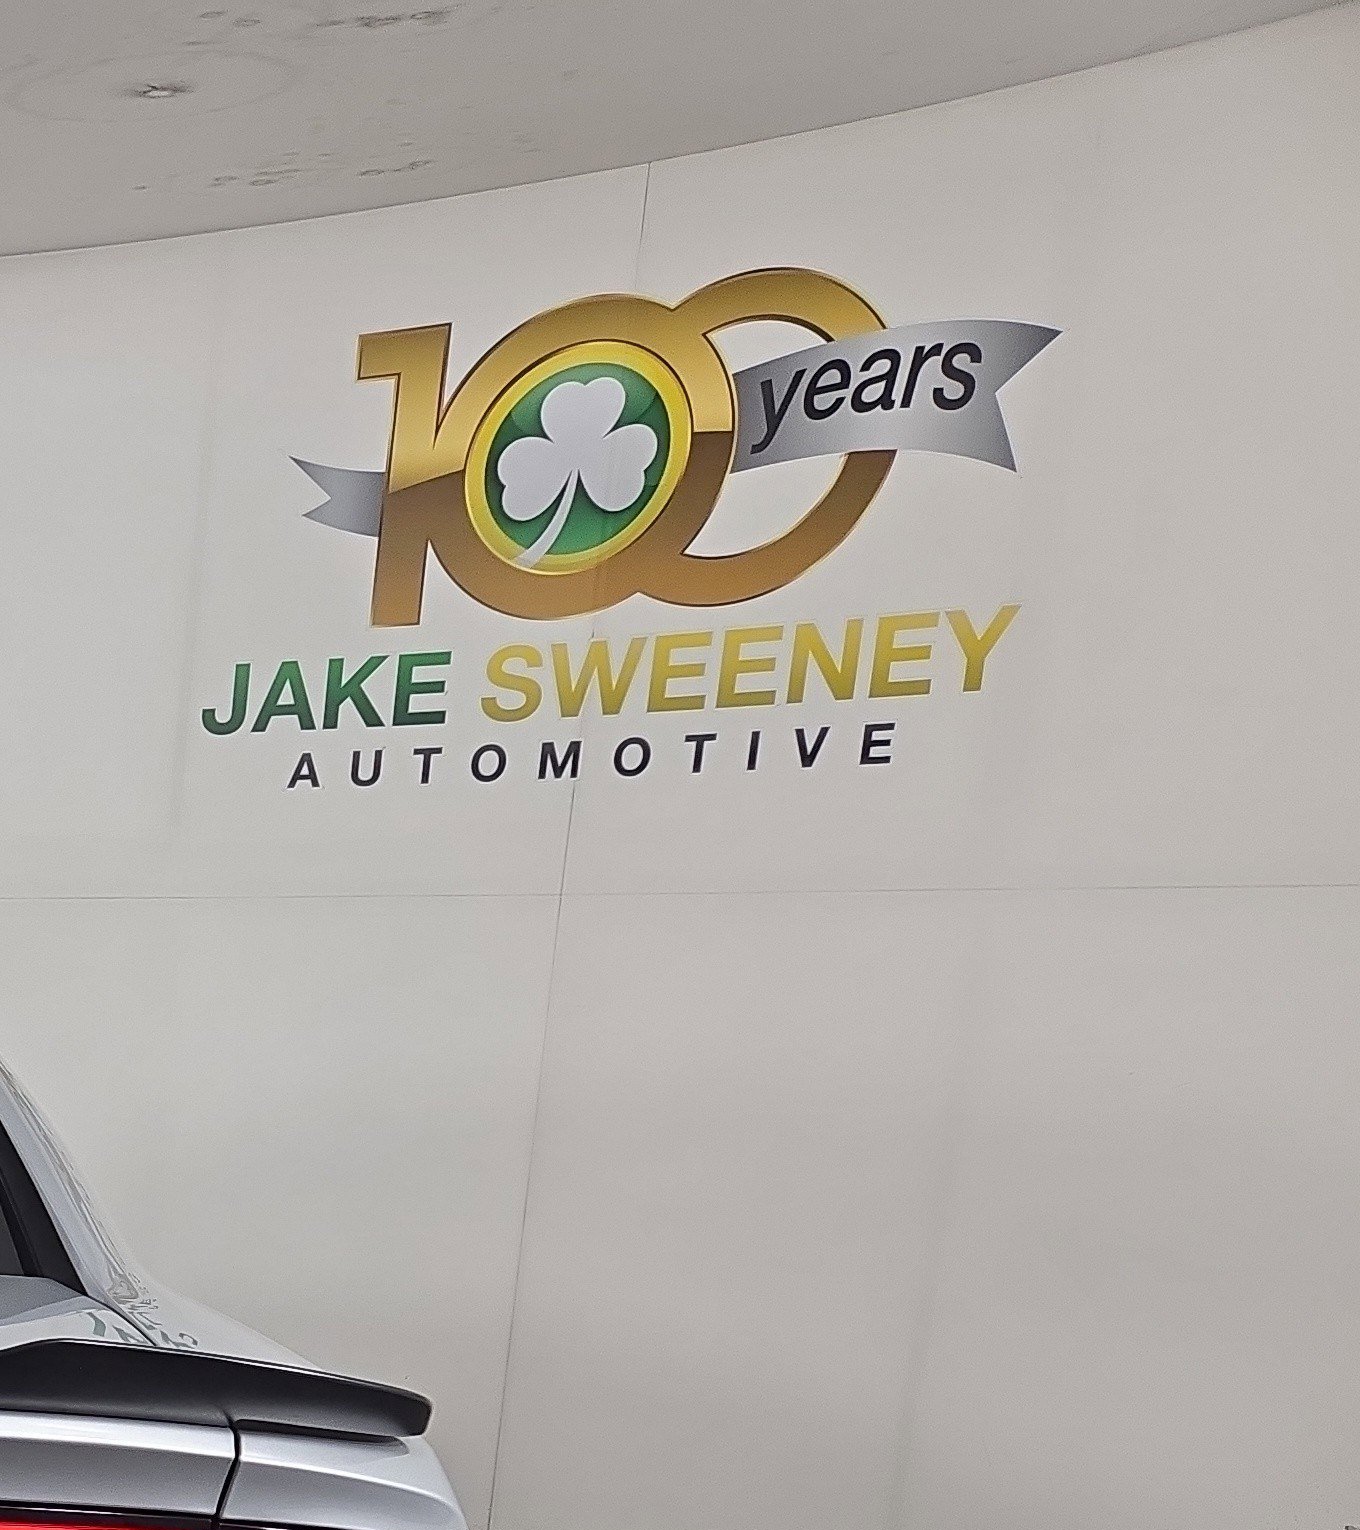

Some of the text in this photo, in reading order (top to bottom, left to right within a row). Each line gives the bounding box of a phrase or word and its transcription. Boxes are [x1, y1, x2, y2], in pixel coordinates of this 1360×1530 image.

[748, 338, 983, 456] years
[201, 604, 1022, 737] JAKE SWEENEY
[287, 721, 897, 790] AUTOMOTIVE
